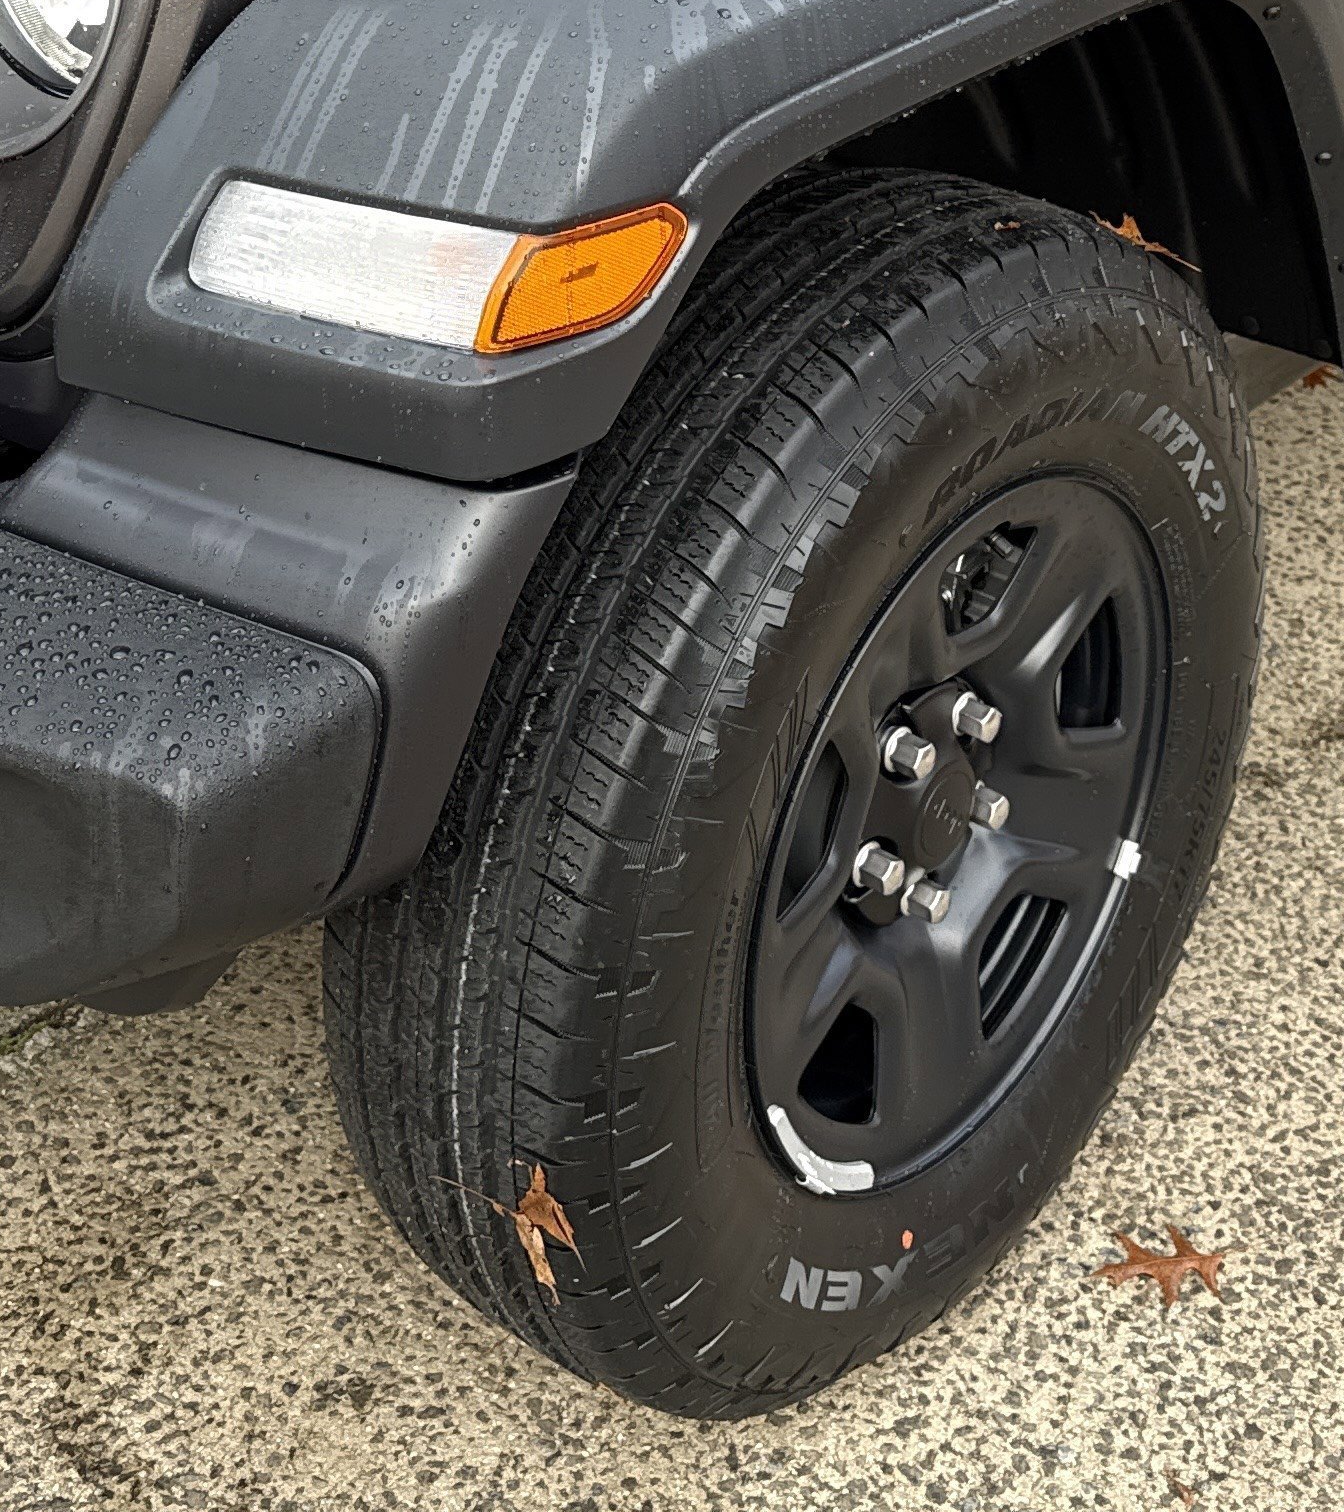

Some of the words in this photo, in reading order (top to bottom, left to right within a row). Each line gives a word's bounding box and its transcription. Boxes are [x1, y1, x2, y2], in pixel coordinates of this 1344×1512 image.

[921, 387, 1148, 530] ROADIAN
[1137, 404, 1227, 522] HTX2
[779, 1176, 1017, 1313] NEXEN
